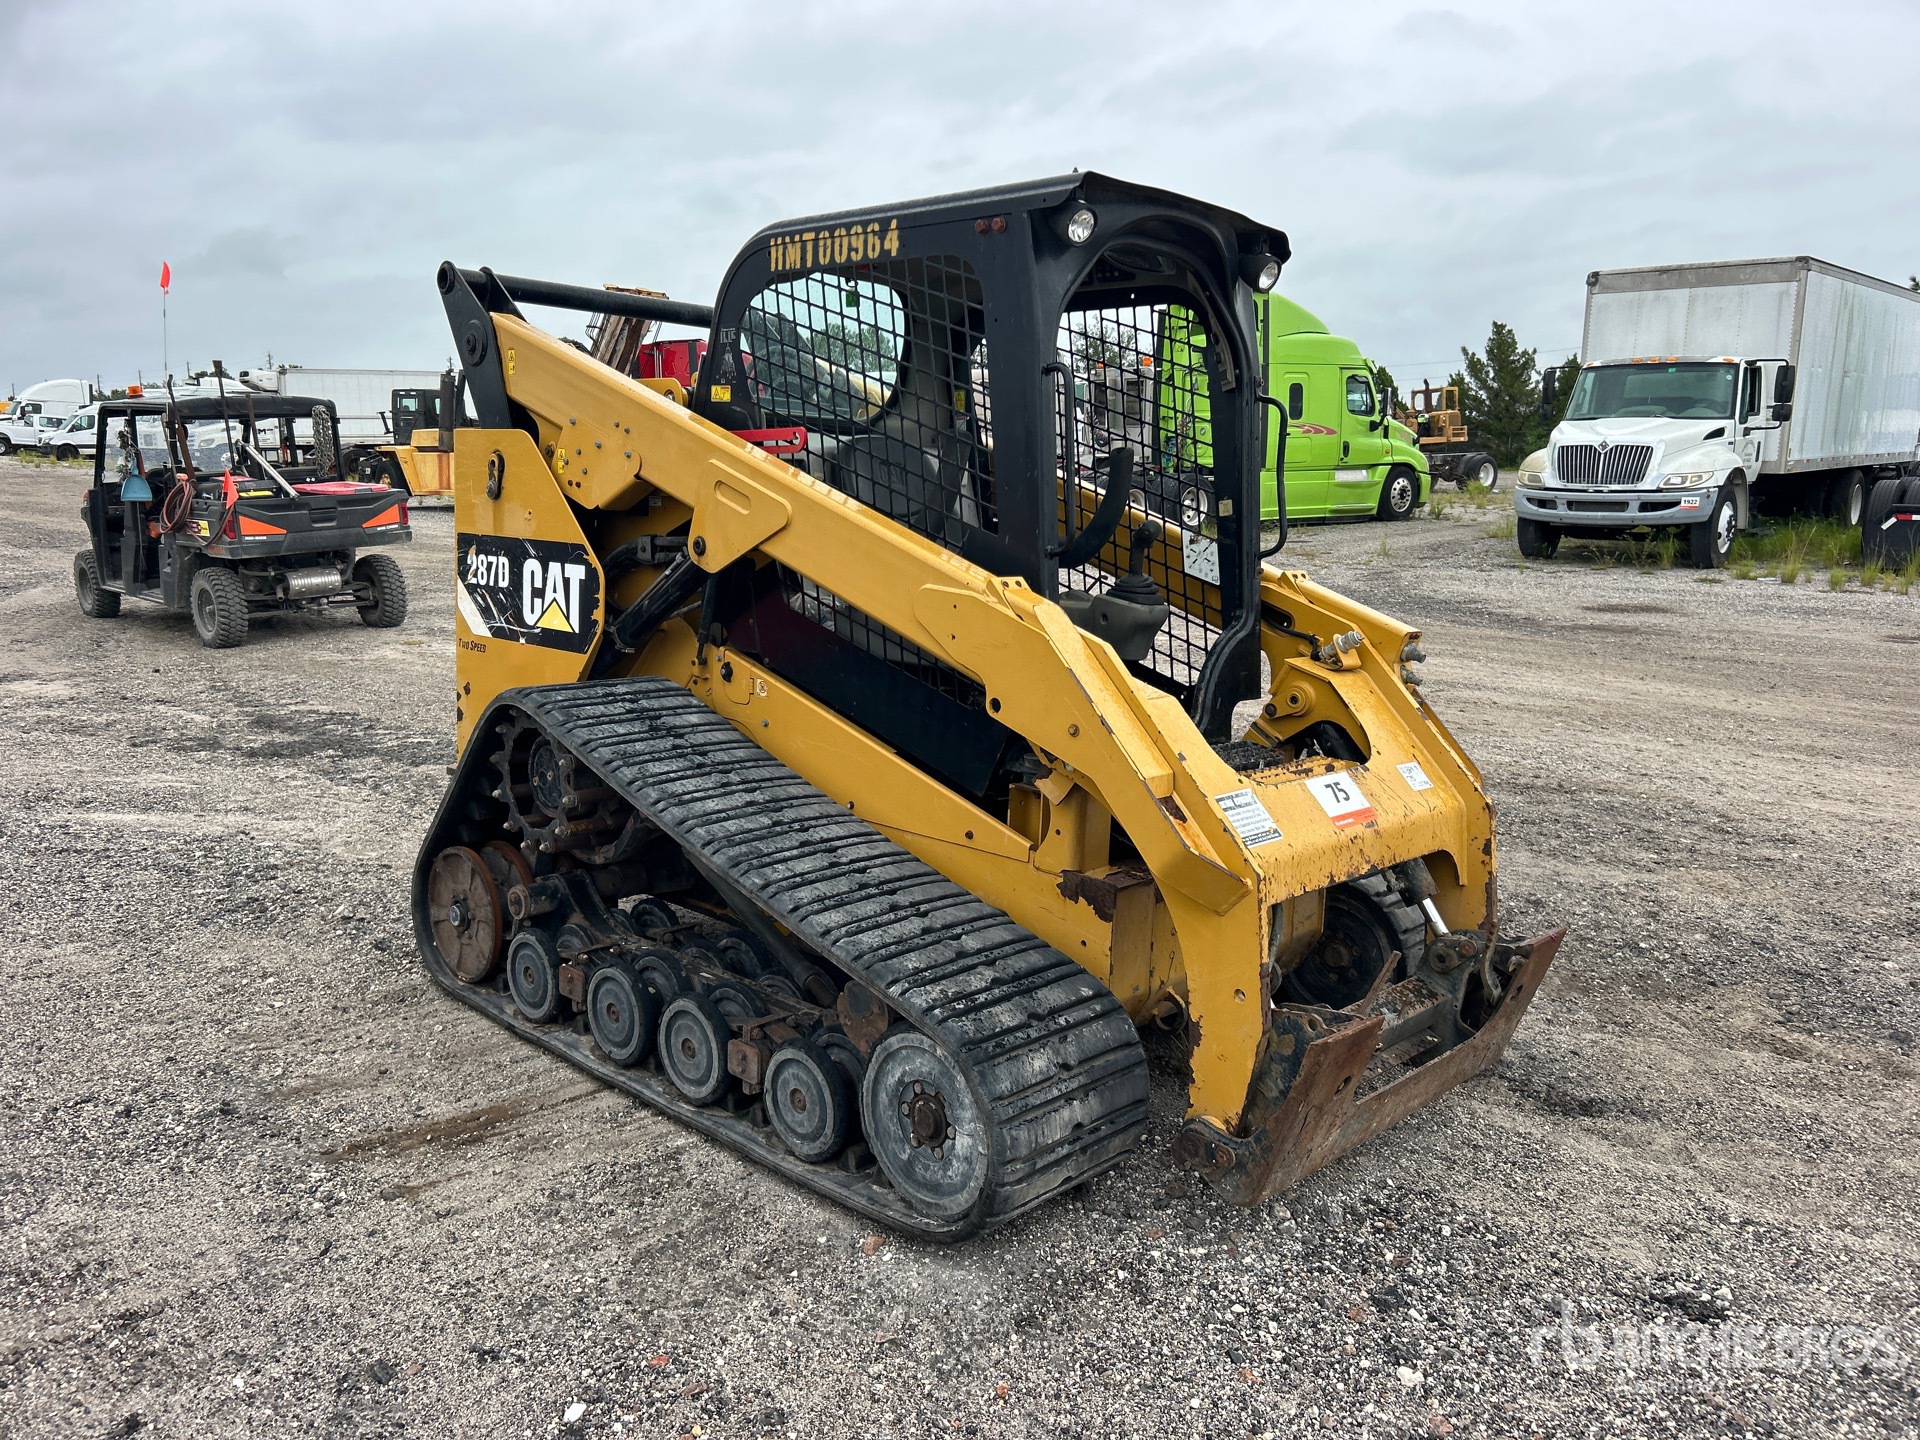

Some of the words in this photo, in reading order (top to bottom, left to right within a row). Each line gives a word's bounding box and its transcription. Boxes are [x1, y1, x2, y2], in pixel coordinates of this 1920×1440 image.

[769, 218, 899, 272] HMT00964
[466, 550, 510, 588] 287D
[522, 558, 586, 634] CAT
[1323, 781, 1351, 804] 75
